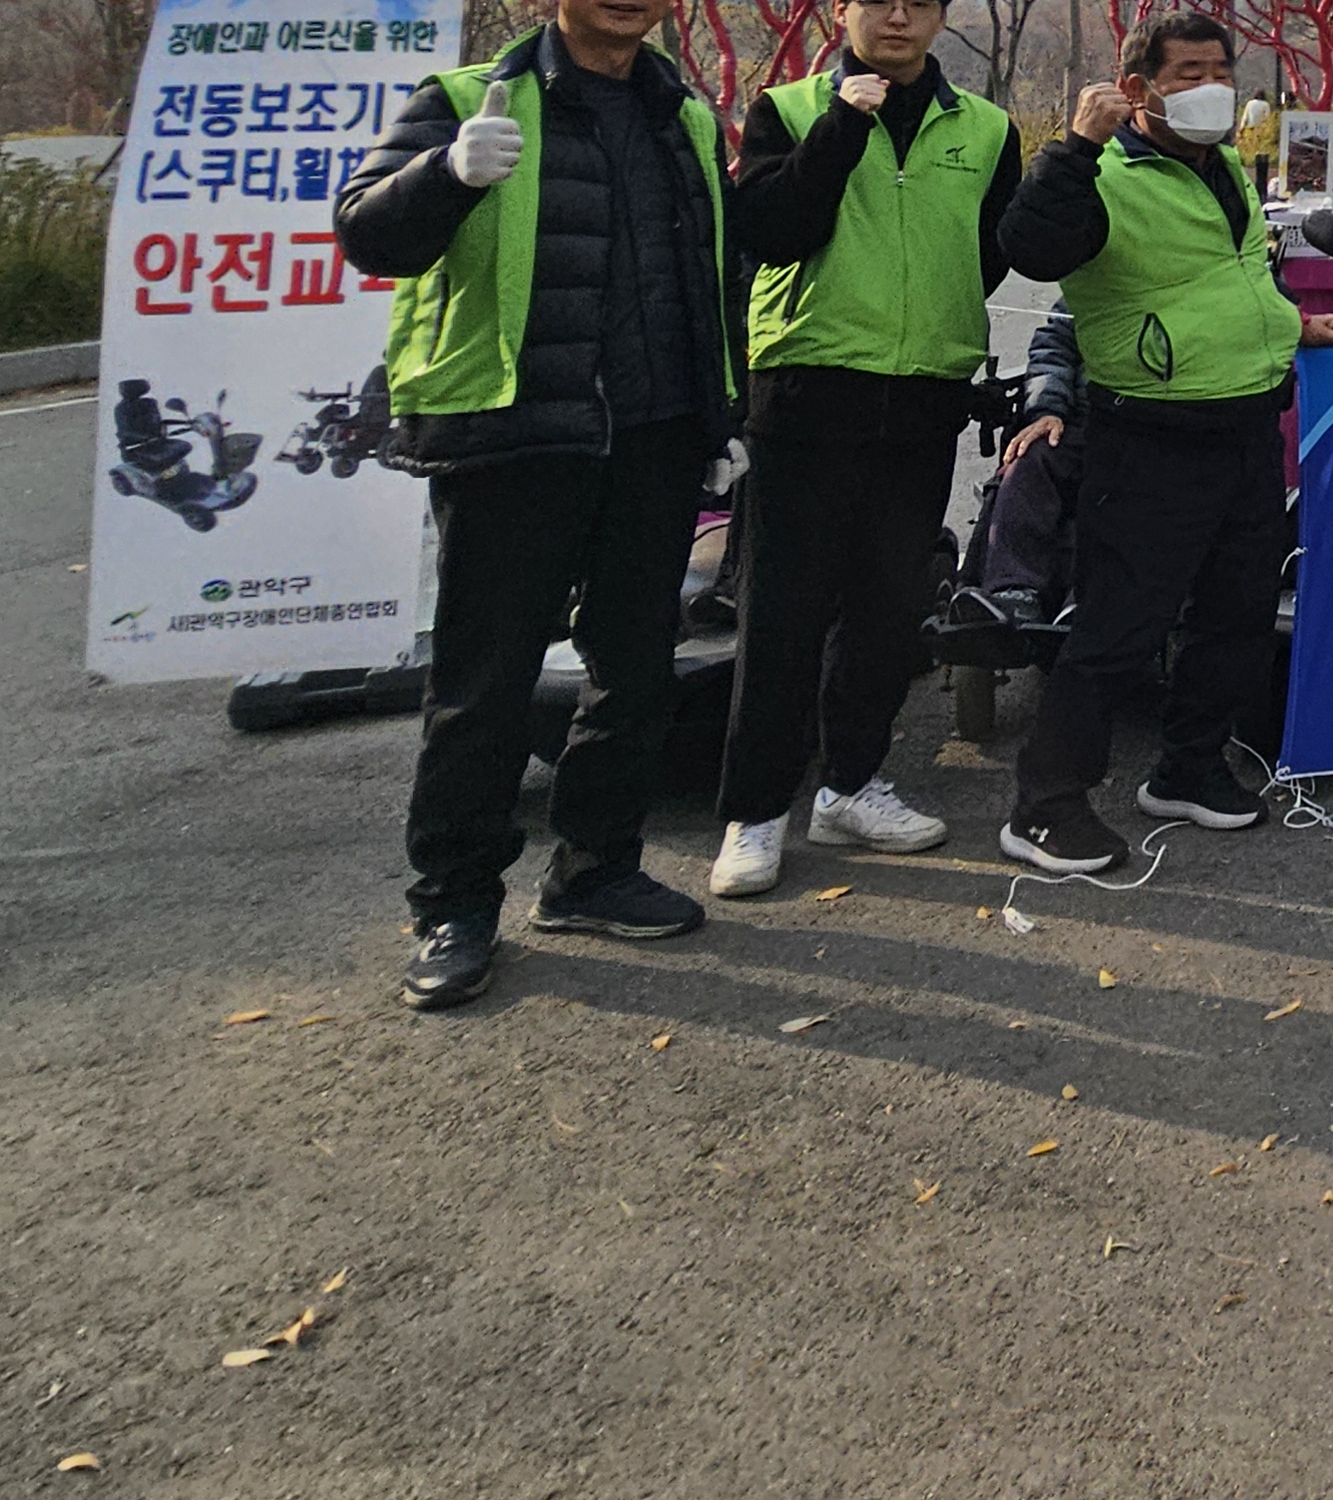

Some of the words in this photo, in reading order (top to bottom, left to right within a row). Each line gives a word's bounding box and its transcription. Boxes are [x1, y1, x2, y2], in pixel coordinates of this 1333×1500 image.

[168, 22, 269, 55] 장애인과
[277, 20, 378, 52] 어르신을
[386, 20, 438, 52] 위한
[153, 82, 416, 138] 전동보조기
[134, 231, 397, 315] 안전교
[237, 576, 312, 599] 관악구
